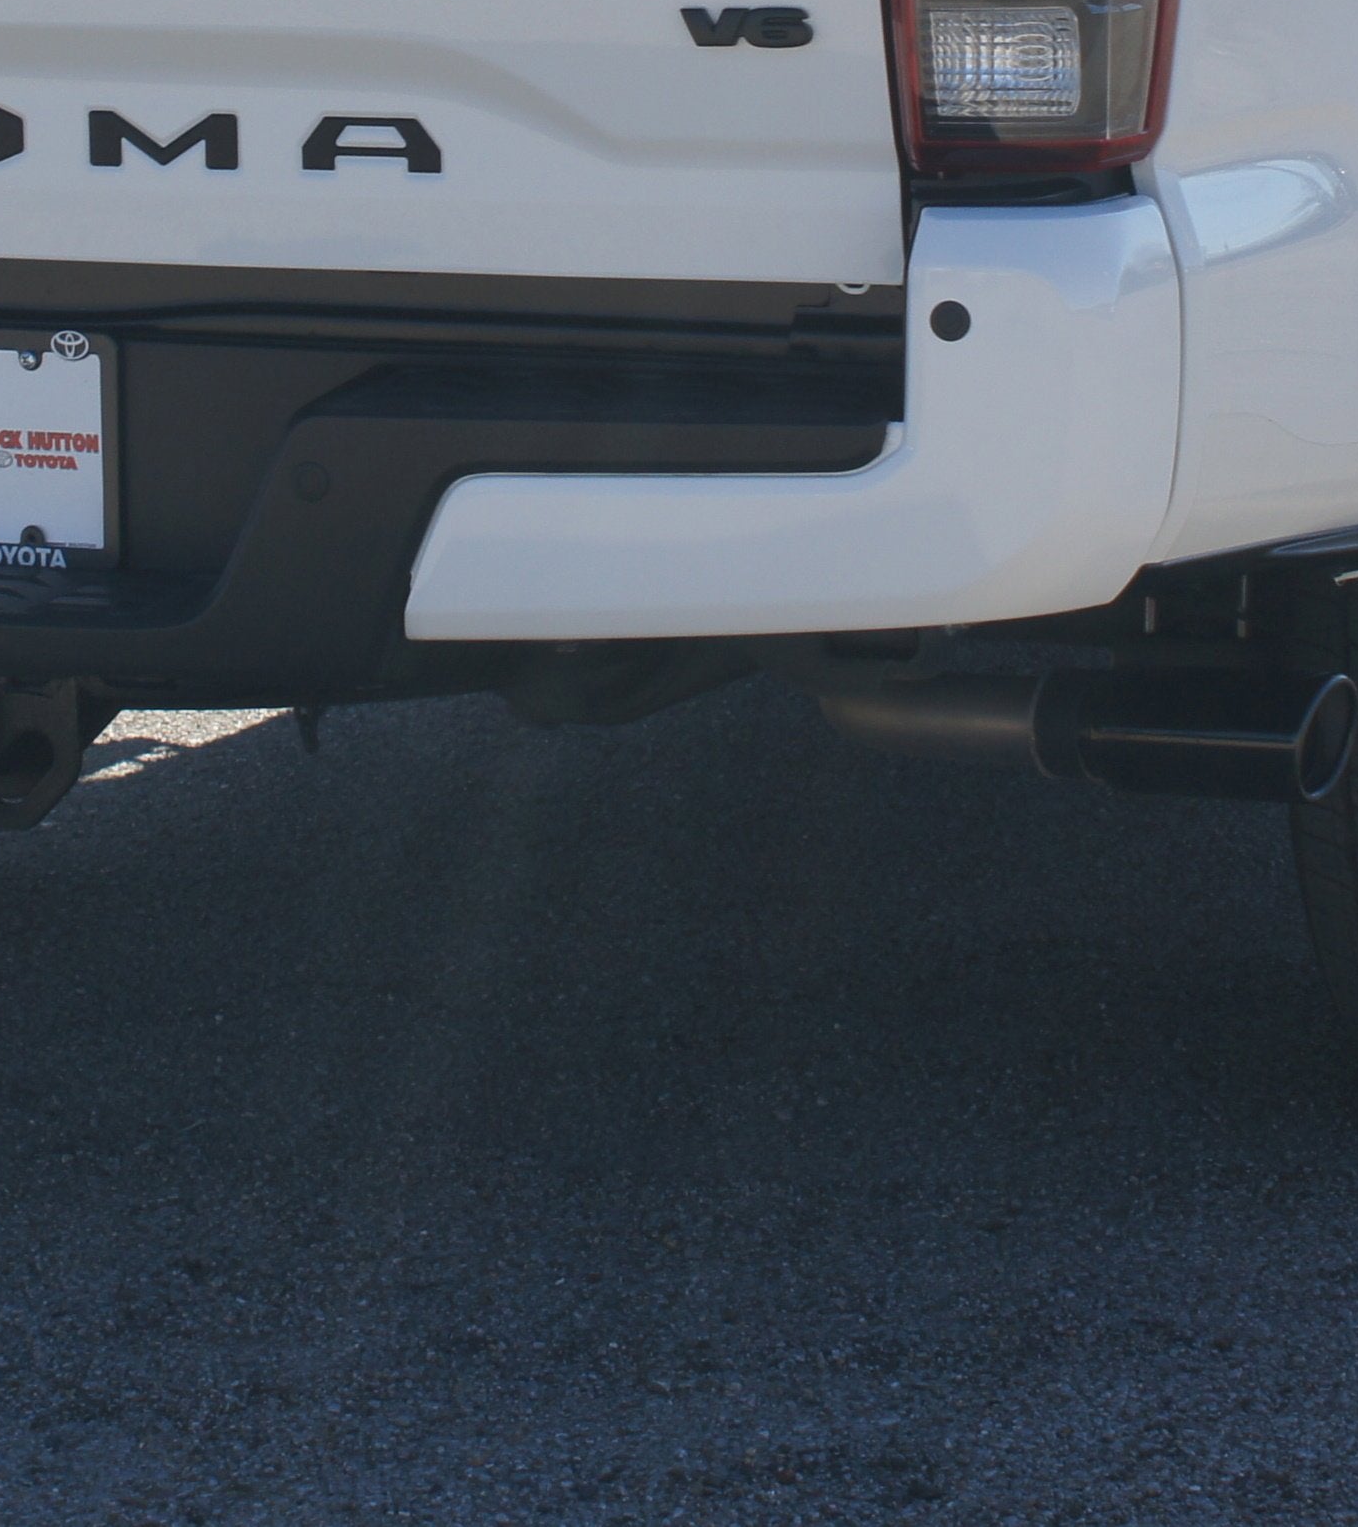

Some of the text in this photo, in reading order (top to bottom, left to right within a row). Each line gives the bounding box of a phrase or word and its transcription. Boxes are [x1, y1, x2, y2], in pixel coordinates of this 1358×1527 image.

[679, 4, 815, 50] V6
[27, 431, 100, 453] HUTTON
[14, 453, 79, 470] TOYOTA
